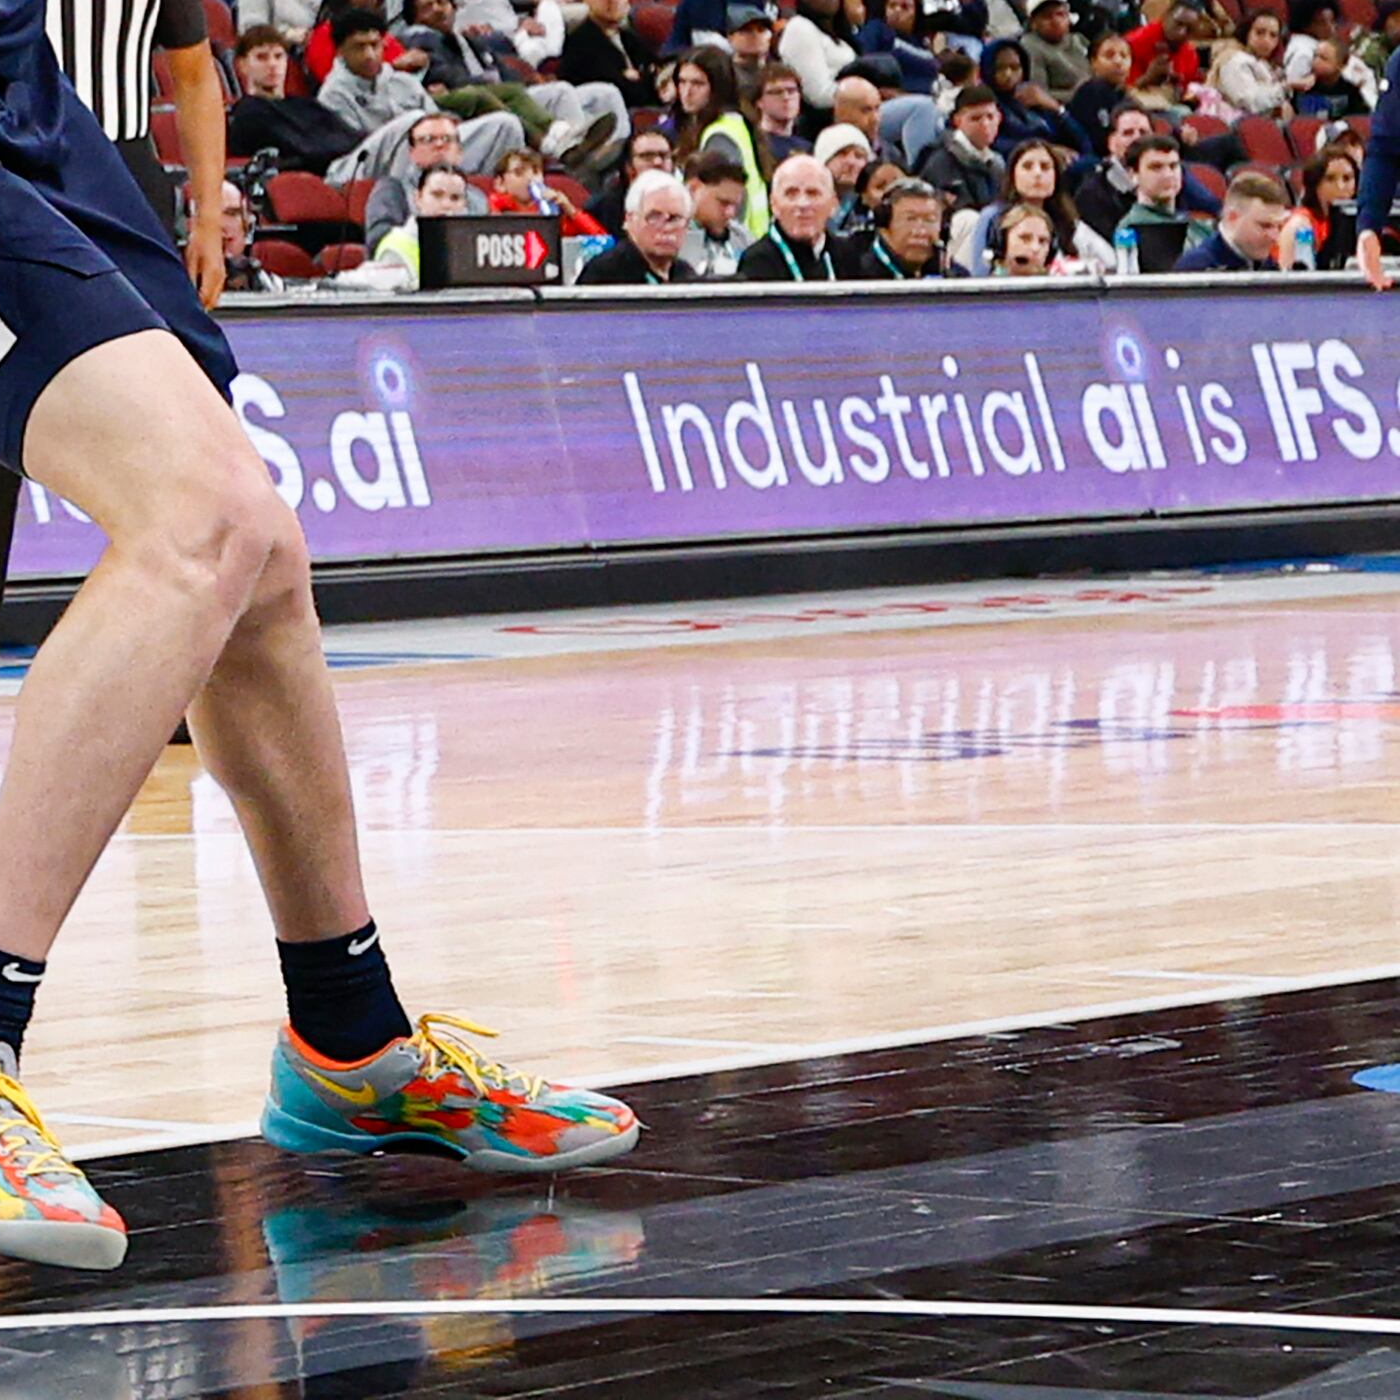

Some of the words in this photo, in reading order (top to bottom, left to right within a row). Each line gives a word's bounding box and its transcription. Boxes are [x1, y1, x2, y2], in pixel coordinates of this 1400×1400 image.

[476, 233, 526, 267] POSS
[624, 351, 1067, 493] Industrial
[1082, 333, 1167, 472] ai
[1165, 347, 1248, 466] is
